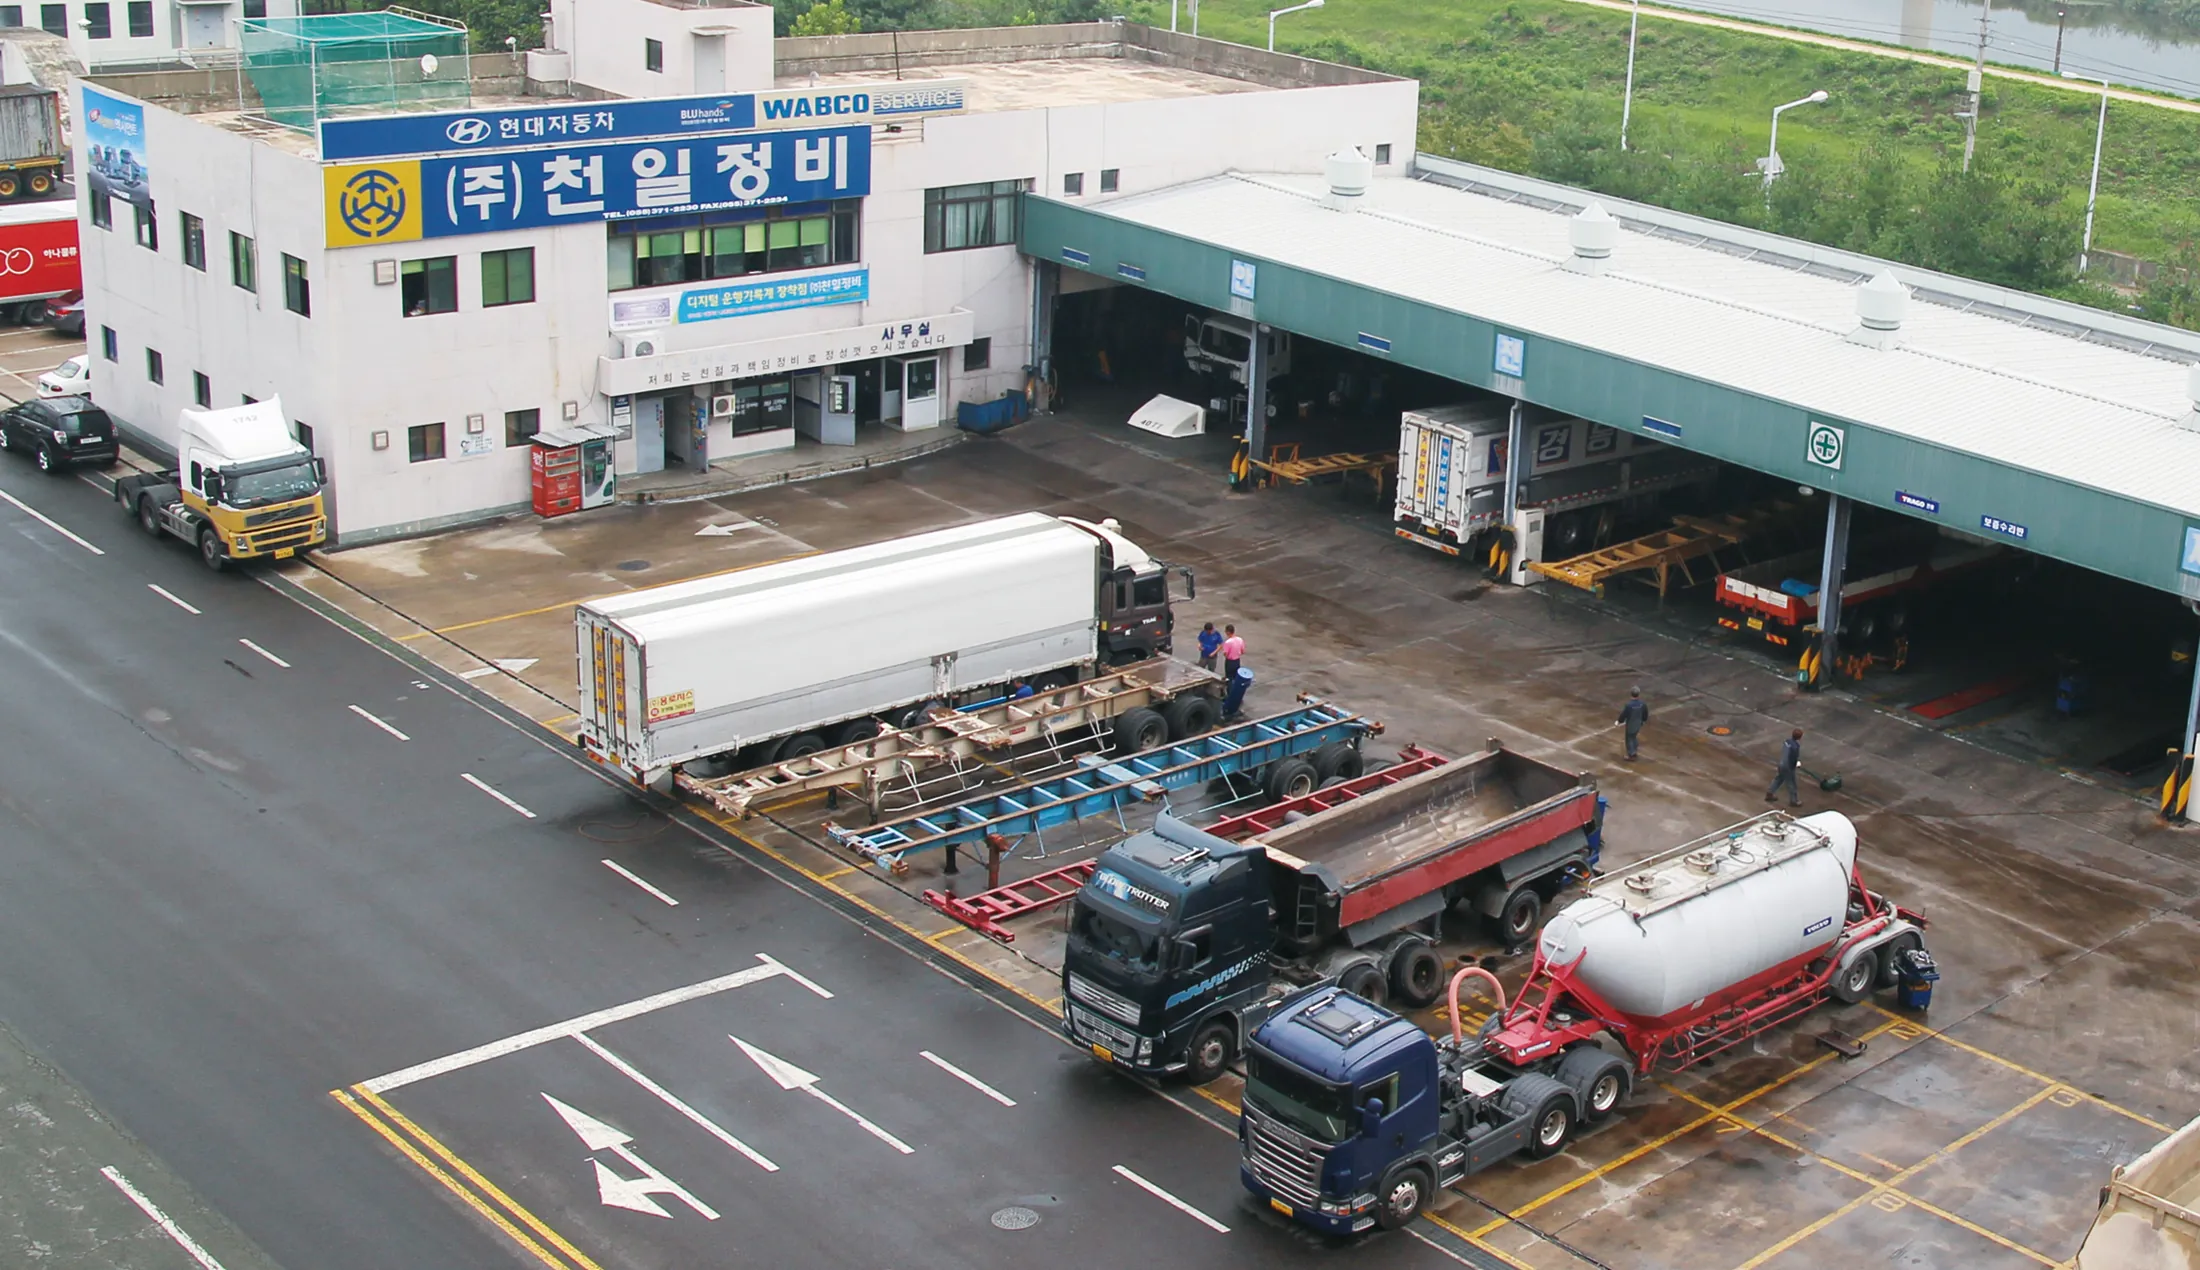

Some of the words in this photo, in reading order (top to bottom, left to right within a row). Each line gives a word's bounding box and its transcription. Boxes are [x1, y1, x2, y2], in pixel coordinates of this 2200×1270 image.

[763, 93, 869, 120] WABCO
[879, 89, 957, 110] SERVICE
[499, 111, 615, 139] 현대자동차
[687, 292, 718, 309] 디지털
[722, 286, 775, 304] 운행기록계
[777, 282, 808, 299] 장착점
[881, 321, 930, 341] 사무실
[648, 370, 690, 385] 저희는
[700, 362, 740, 379] 친절과
[232, 414, 259, 425] 1742
[1806, 919, 1829, 933] VOLVO
